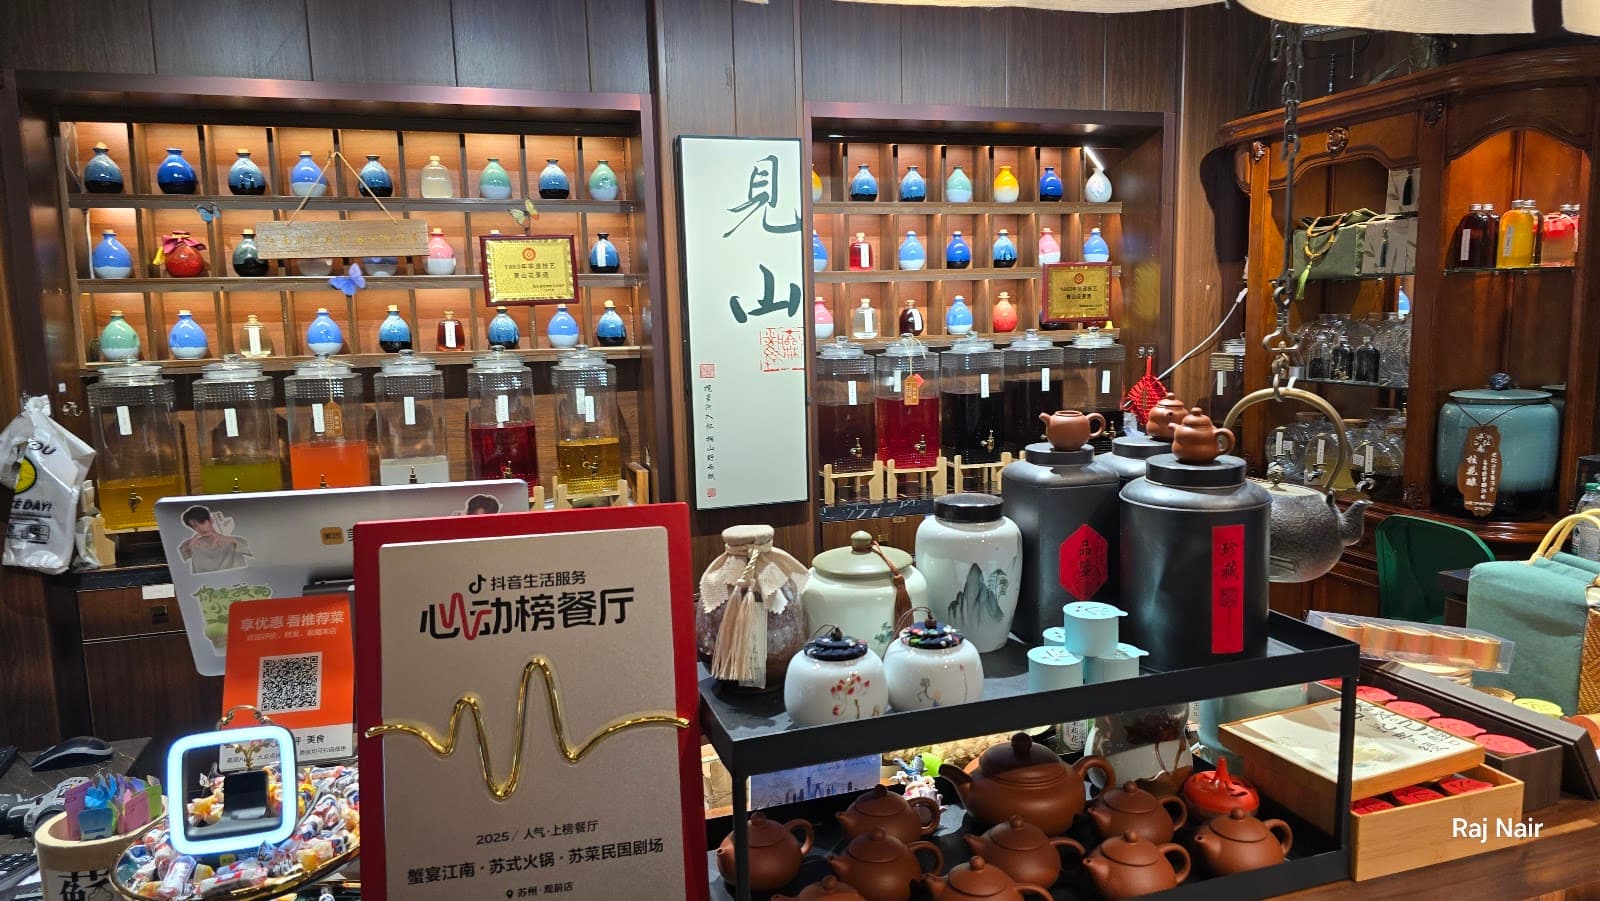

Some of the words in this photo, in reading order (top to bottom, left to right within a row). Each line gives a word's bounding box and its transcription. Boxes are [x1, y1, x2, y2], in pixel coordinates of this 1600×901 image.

[723, 154, 802, 324] 見山
[490, 570, 587, 591] 抖音生活服务
[239, 615, 284, 631] 享优惠
[287, 610, 345, 627] 看推荐菜
[419, 587, 635, 640] 心动榜餐厅
[475, 830, 510, 846] 2025
